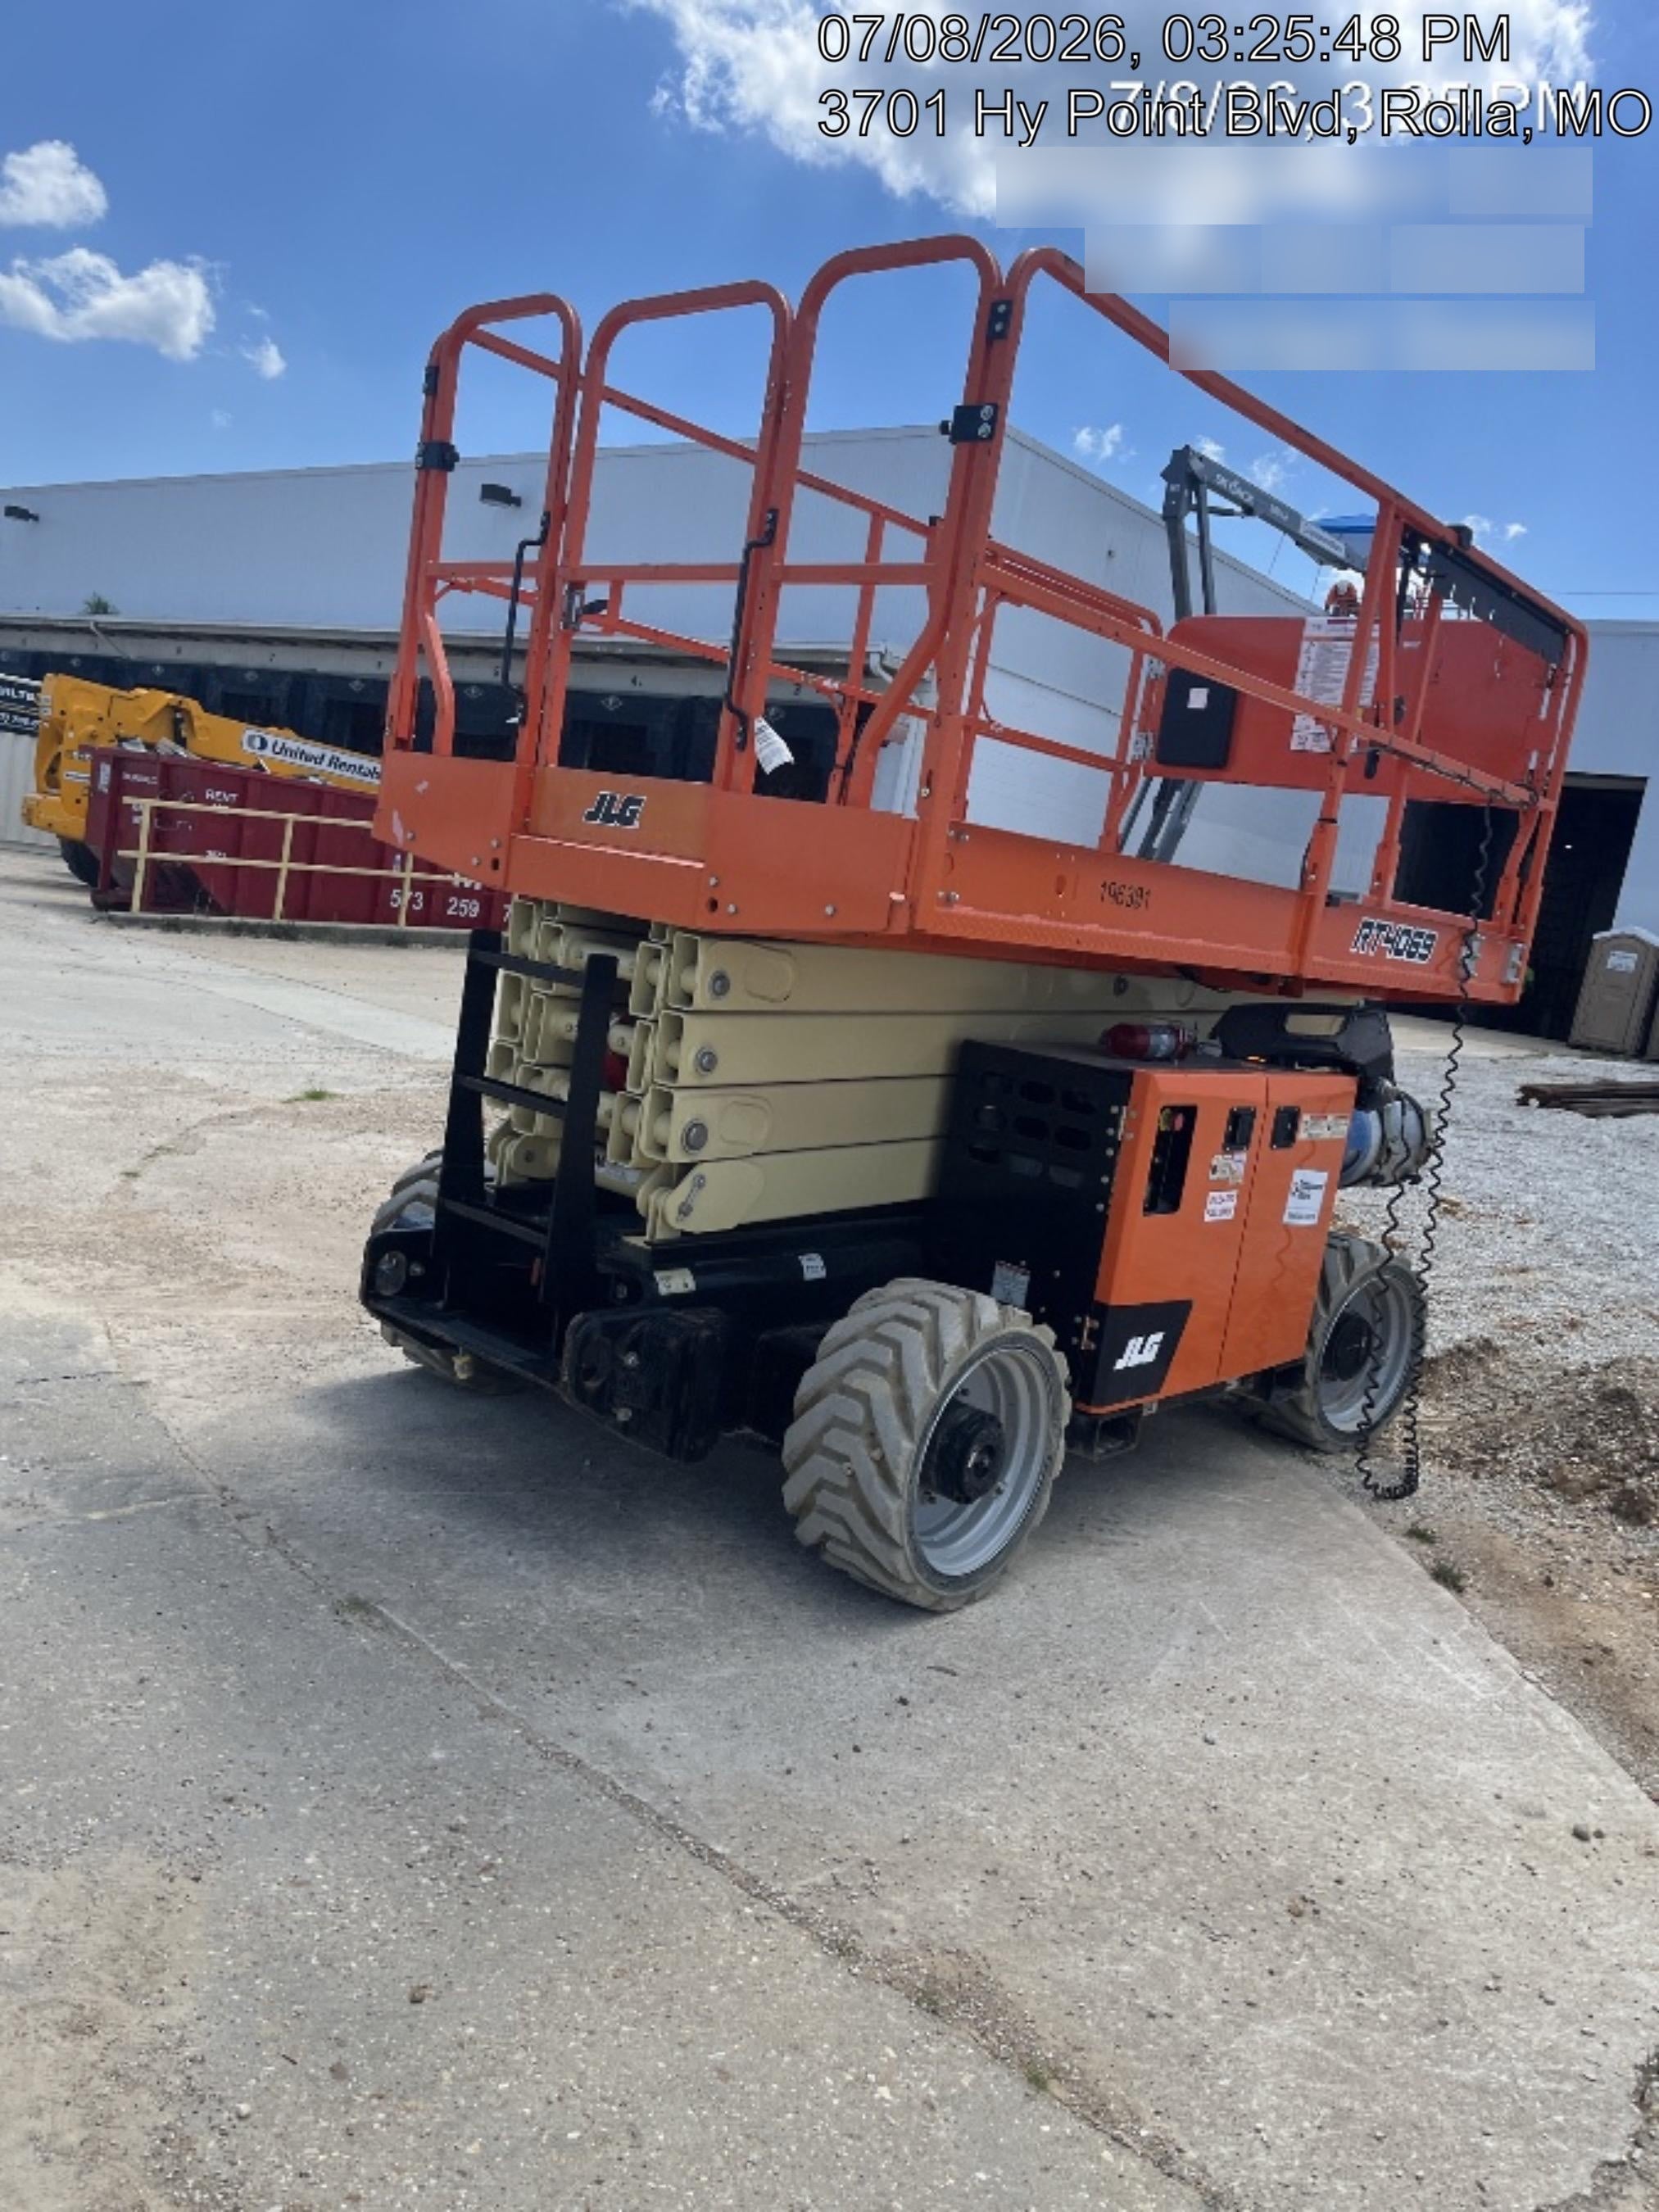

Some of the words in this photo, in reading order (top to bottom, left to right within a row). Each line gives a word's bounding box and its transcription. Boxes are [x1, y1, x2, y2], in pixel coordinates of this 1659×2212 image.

[272, 739, 325, 766] United
[206, 788, 238, 802] RENT
[582, 791, 647, 829] JLG
[446, 896, 480, 918] 259
[1113, 1331, 1165, 1371] JLG
